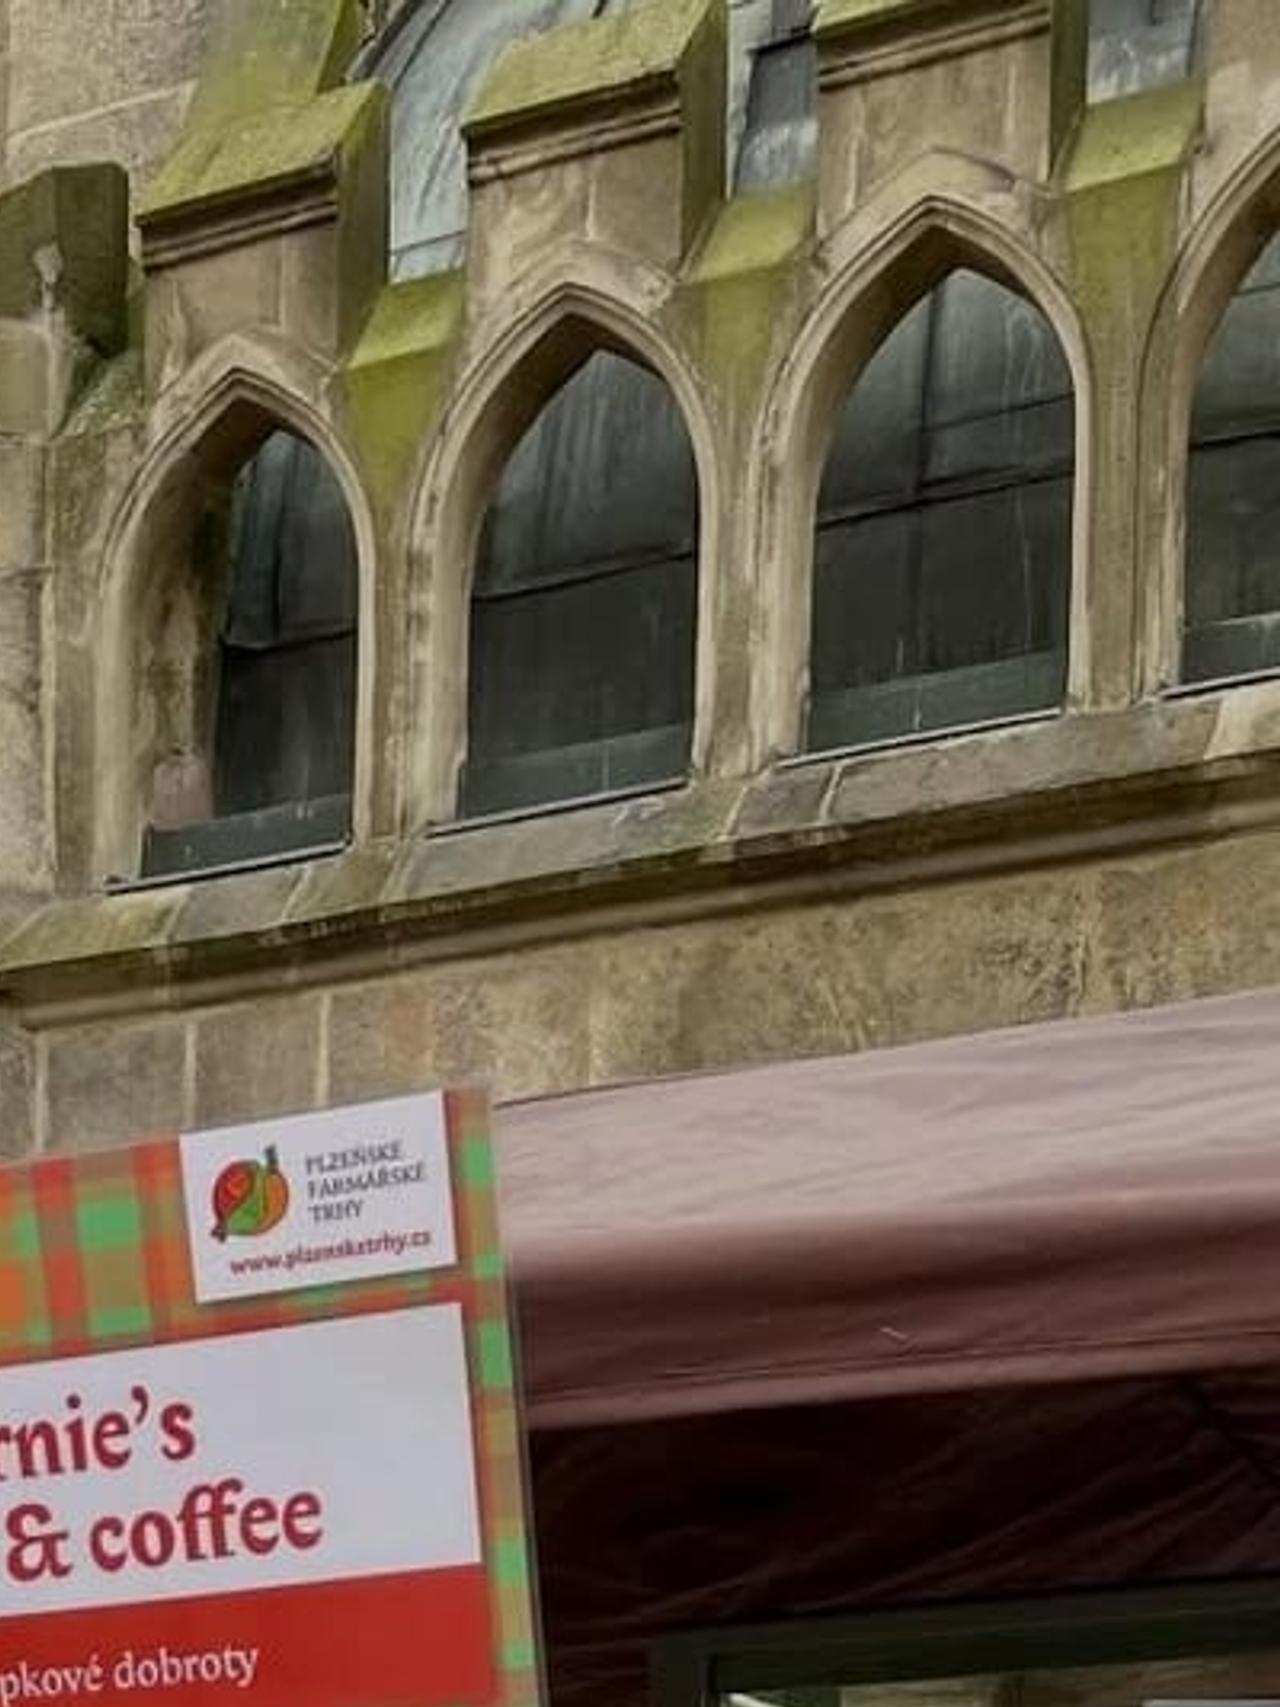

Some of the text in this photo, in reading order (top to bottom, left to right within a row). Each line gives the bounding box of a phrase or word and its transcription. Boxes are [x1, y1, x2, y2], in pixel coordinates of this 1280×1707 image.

[5, 1502, 74, 1581] &
[89, 1477, 324, 1573] coffee
[114, 1646, 259, 1691] dobroty
